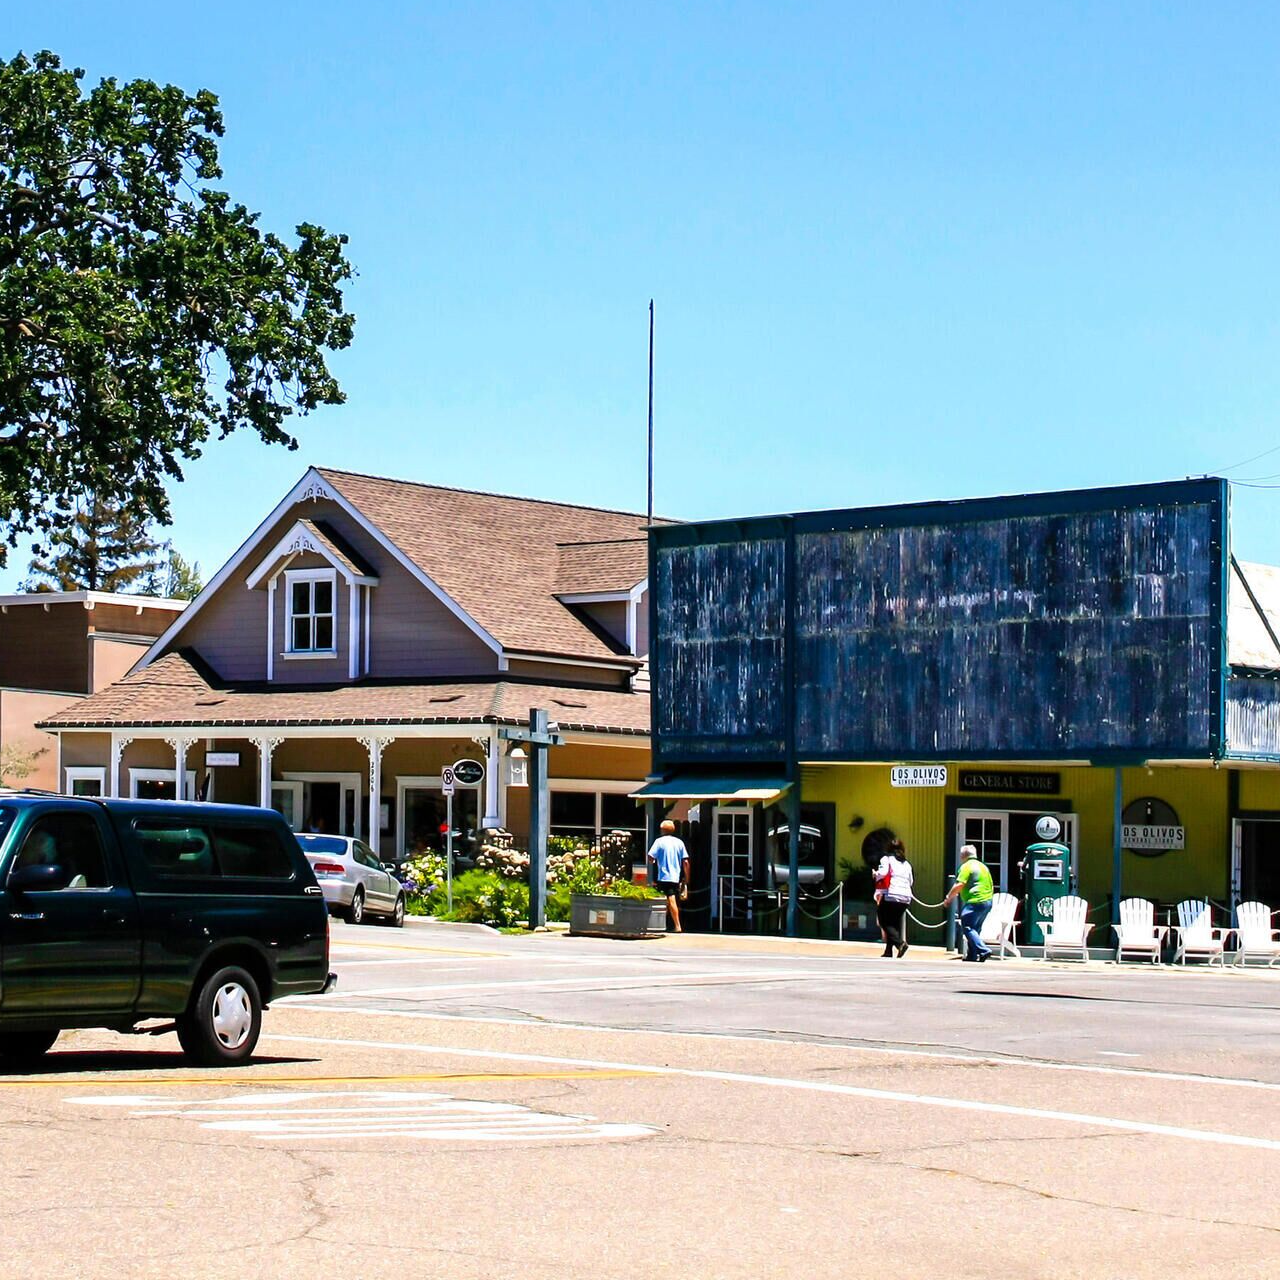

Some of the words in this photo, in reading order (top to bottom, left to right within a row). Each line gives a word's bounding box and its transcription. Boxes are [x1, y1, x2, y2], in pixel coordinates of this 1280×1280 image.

[892, 768, 909, 782] LOS
[913, 768, 946, 781] OLIVOS
[964, 774, 1015, 788] GENERAL
[1019, 775, 1053, 790] STORE
[1123, 826, 1137, 837] OS
[1142, 827, 1184, 841] OLIVOS
